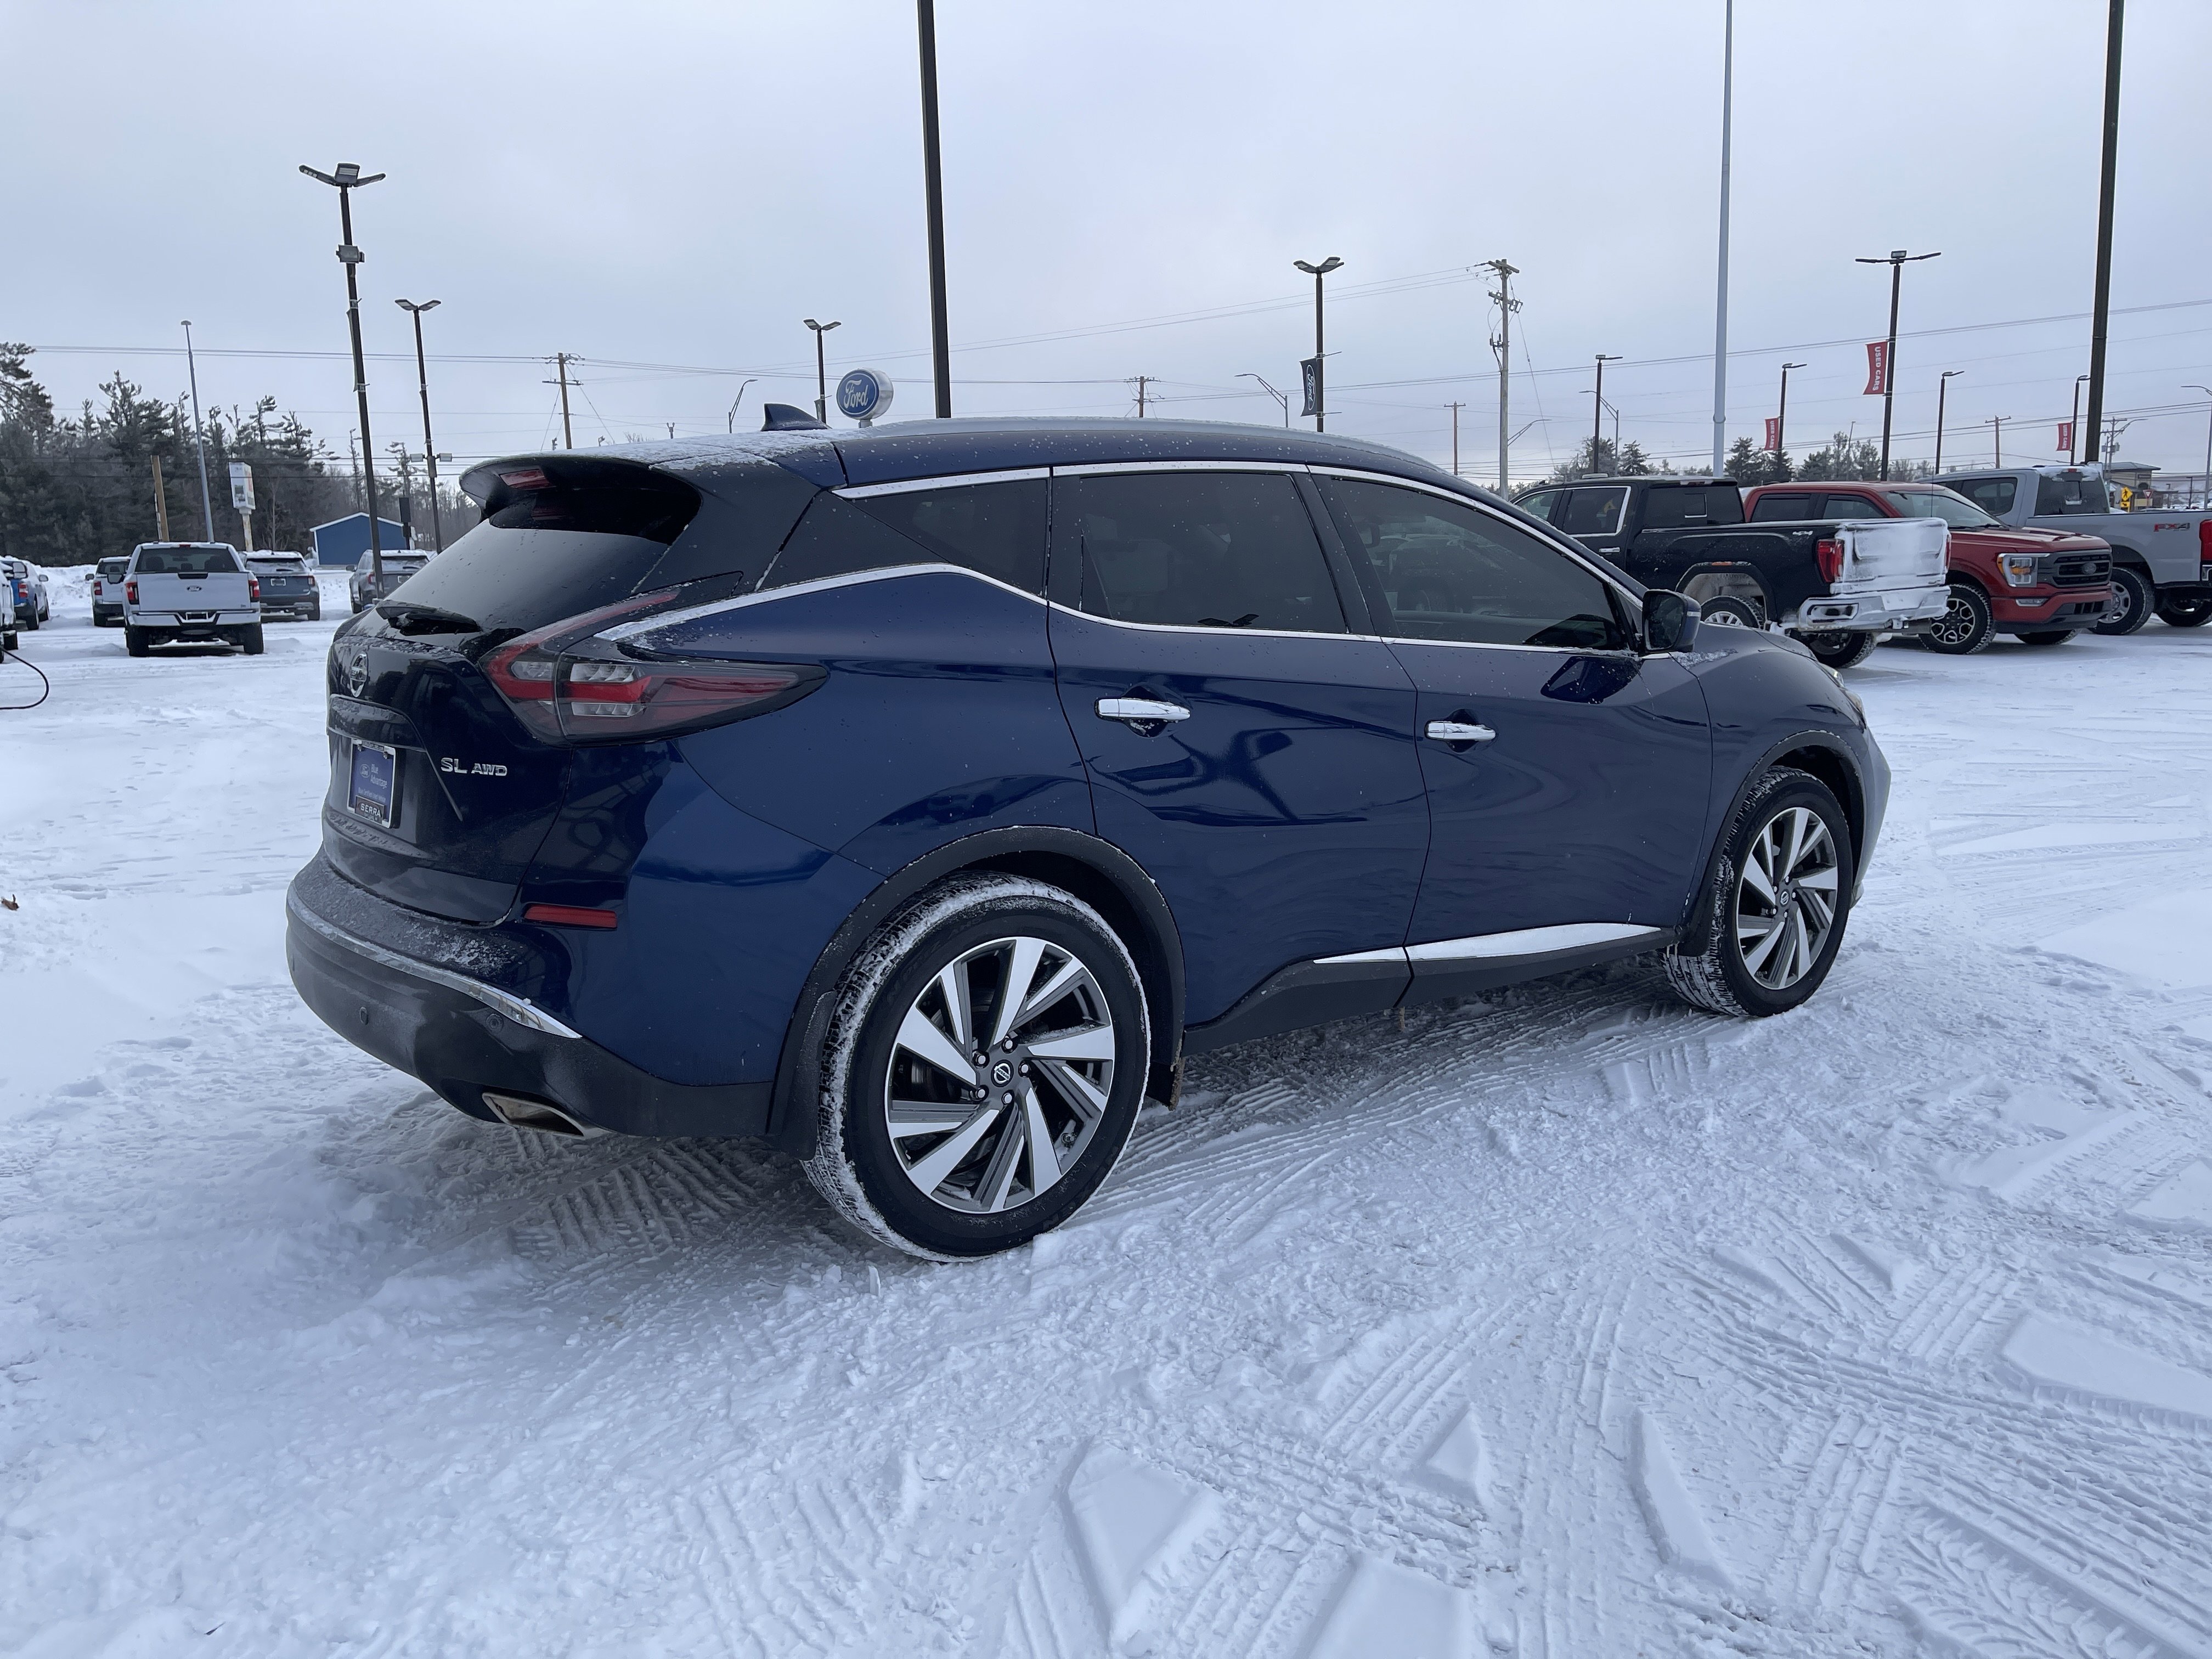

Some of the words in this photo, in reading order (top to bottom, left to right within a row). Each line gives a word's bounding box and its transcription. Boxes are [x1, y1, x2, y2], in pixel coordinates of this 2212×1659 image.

[1872, 369, 1881, 391] CARS
[844, 379, 868, 409] Ford
[441, 757, 467, 774] SL
[471, 763, 507, 776] AWD
[360, 803, 381, 818] SERRA
